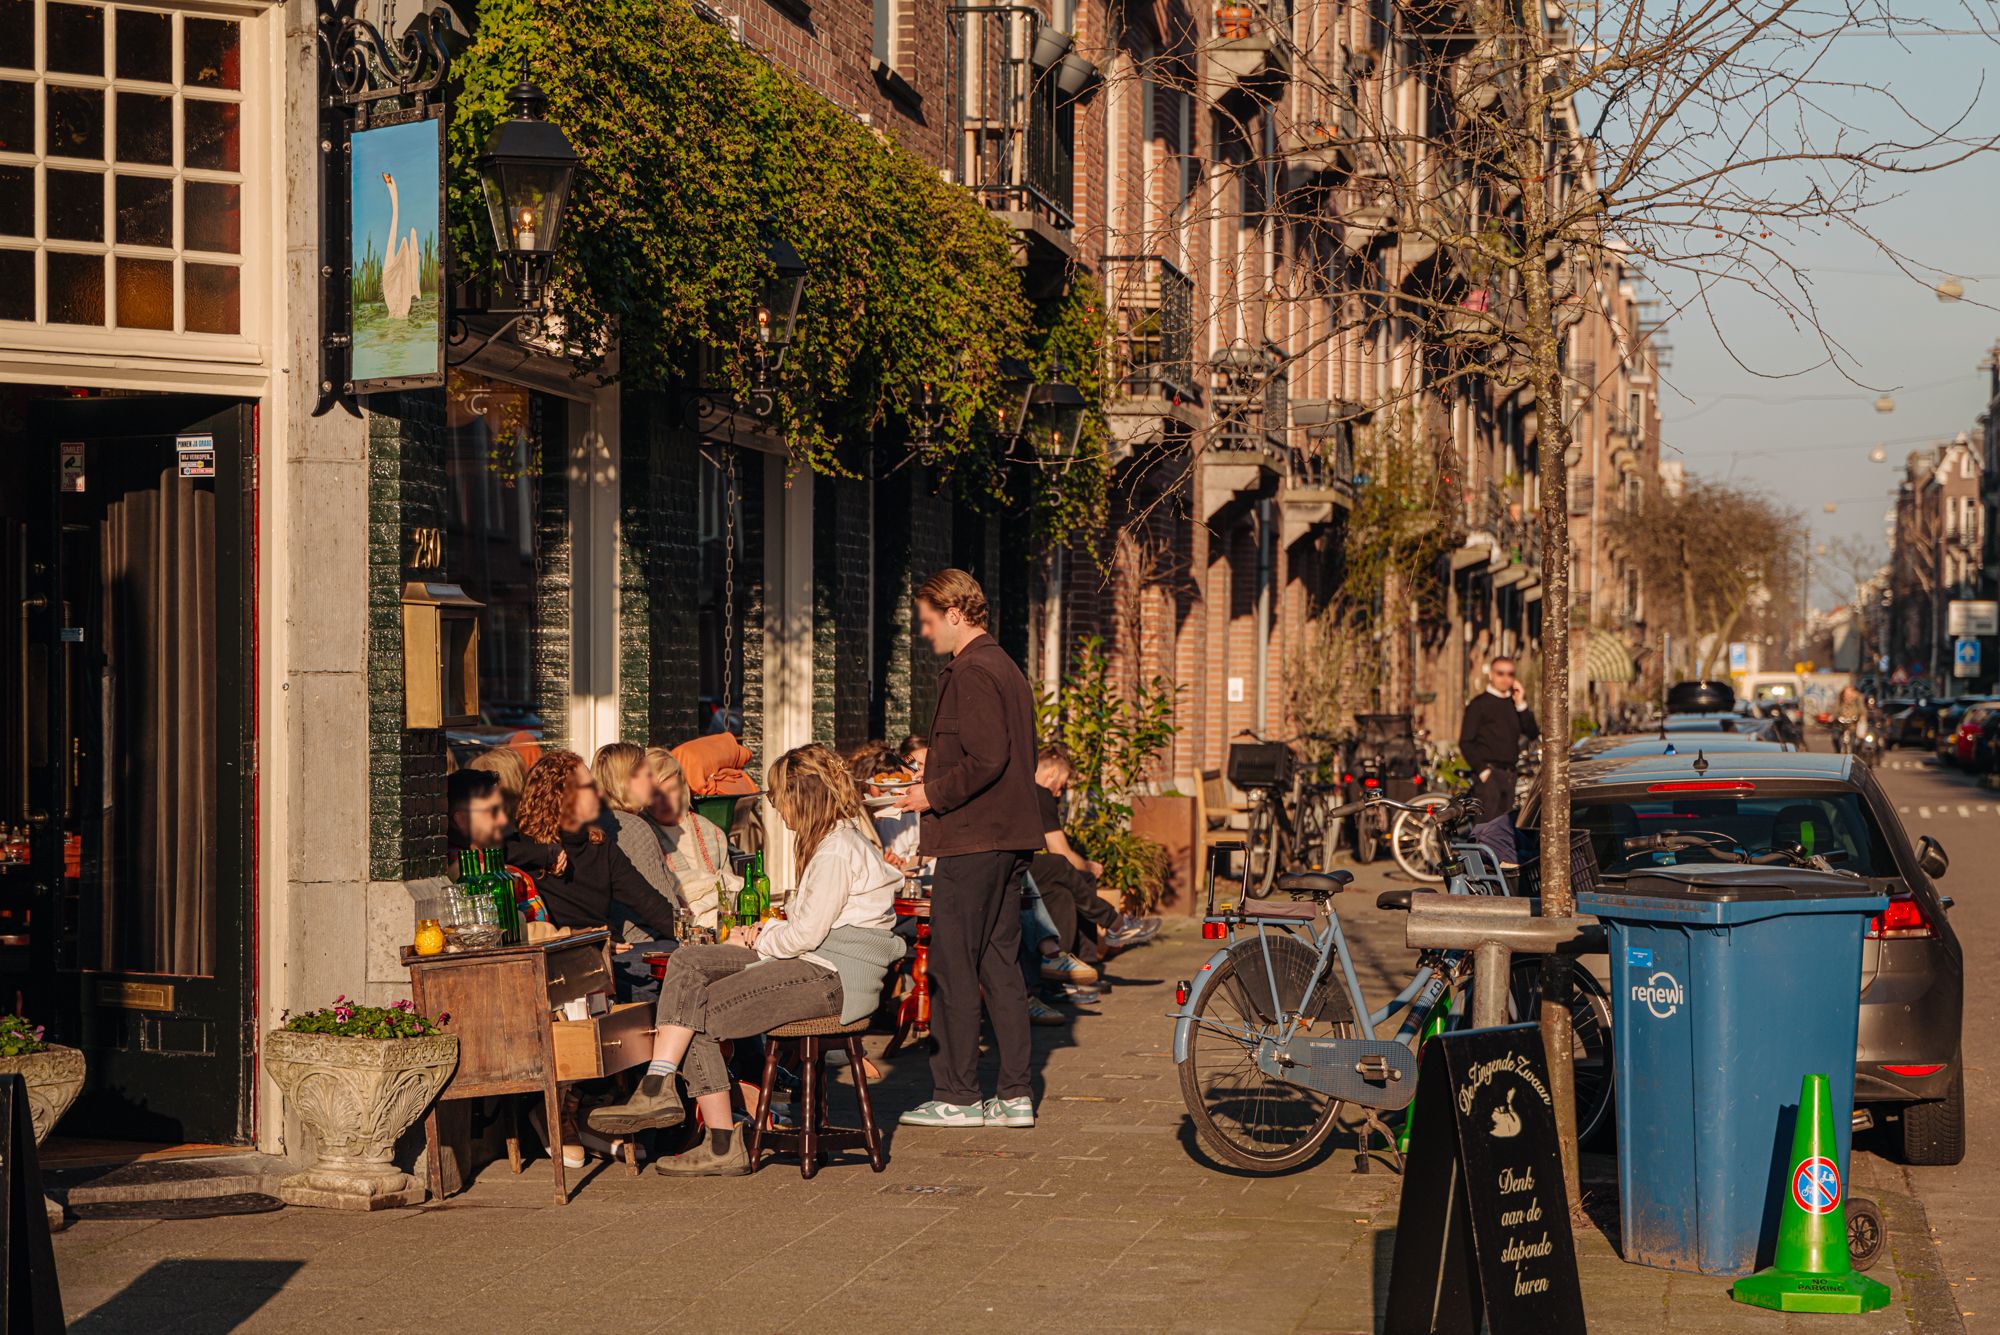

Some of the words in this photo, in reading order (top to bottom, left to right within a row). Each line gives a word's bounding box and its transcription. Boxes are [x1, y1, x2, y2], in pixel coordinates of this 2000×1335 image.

[1631, 984, 1684, 1005] renewi
[1458, 1083, 1476, 1116] De
[1468, 1050, 1516, 1092] Zingende
[1515, 1055, 1552, 1106] Zwaan
[1498, 1166, 1535, 1195] Denk
[1501, 1209, 1525, 1227] aan
[1526, 1197, 1543, 1223] de
[1501, 1231, 1553, 1271] slapende
[1514, 1271, 1550, 1297] buren
